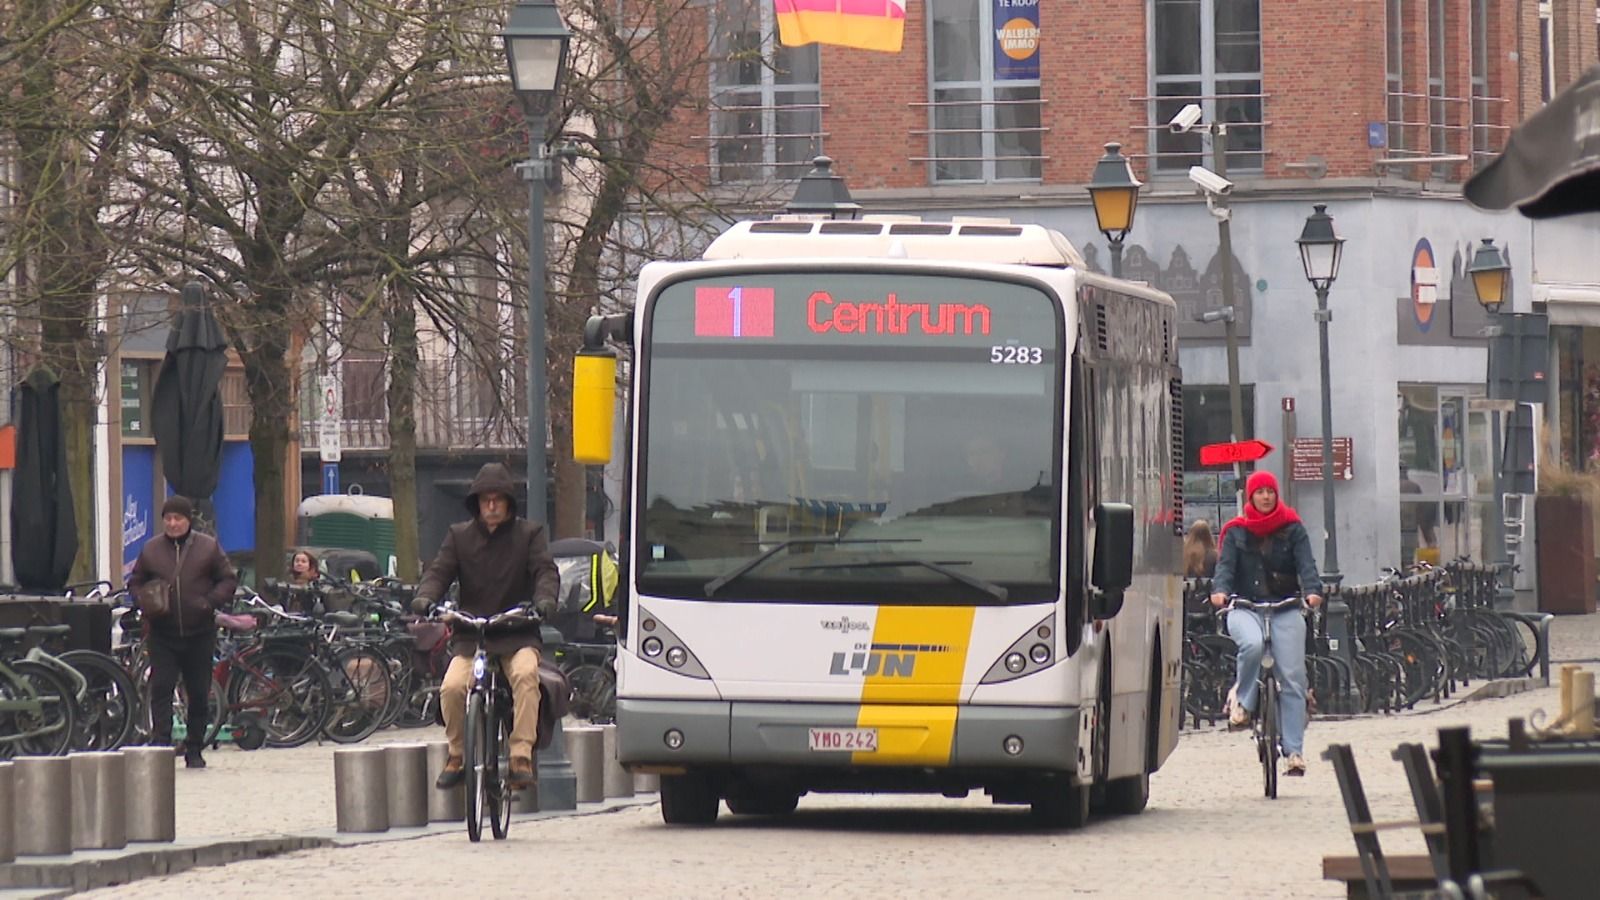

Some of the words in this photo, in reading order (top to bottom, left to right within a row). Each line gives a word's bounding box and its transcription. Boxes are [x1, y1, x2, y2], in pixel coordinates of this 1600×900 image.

[1003, 39, 1035, 49] IMMO
[728, 286, 742, 337] 1
[806, 291, 991, 335] Centrum
[990, 345, 1043, 364] 5283
[829, 652, 916, 677] LIJN
[845, 732, 874, 748] 242
